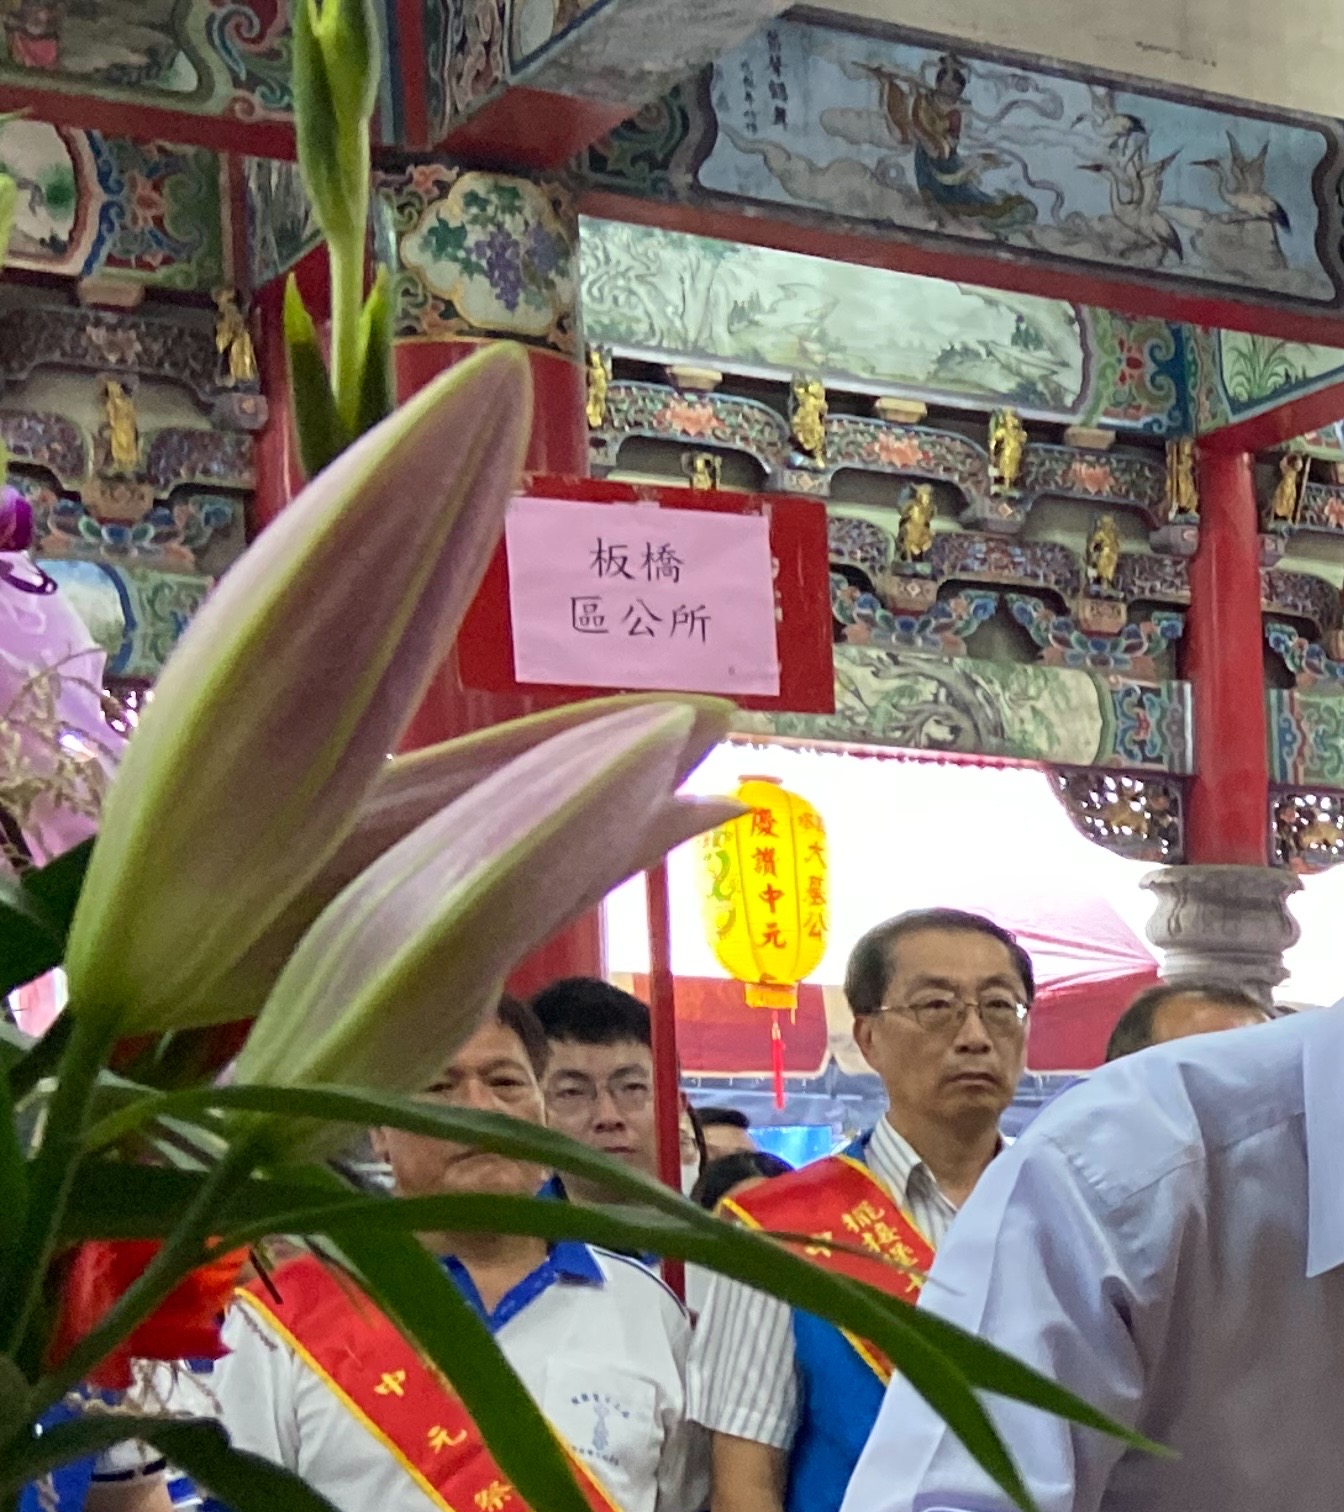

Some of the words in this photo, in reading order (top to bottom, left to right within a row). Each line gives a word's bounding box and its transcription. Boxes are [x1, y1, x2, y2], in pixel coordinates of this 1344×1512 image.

[589, 537, 685, 584] 板橋
[570, 594, 712, 644] 區公所
